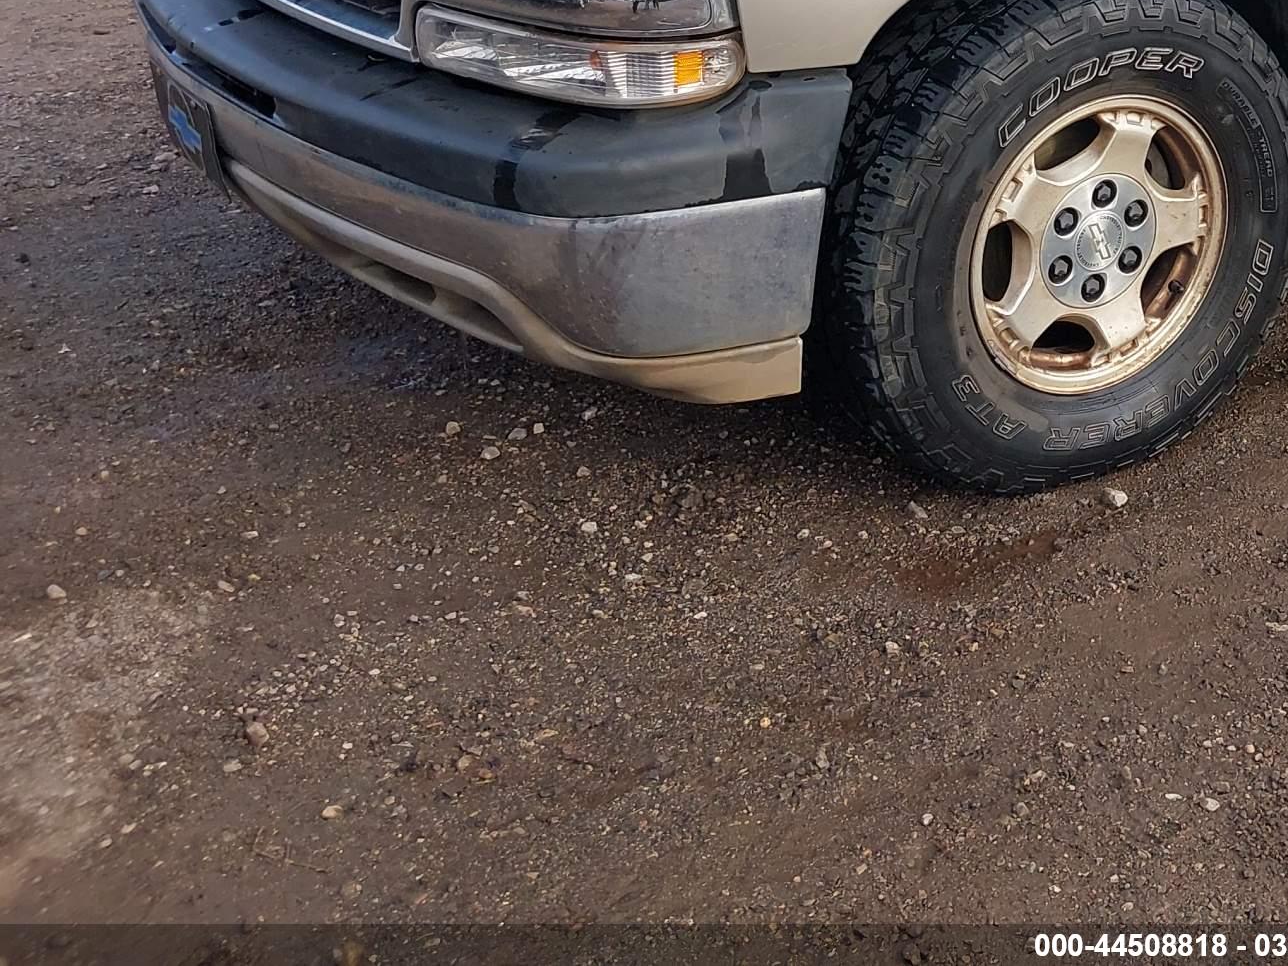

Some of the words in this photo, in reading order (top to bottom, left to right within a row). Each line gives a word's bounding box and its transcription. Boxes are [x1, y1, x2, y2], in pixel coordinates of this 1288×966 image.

[998, 48, 1205, 147] COOPER
[1043, 239, 1274, 452] DISCOVERER
[952, 374, 1029, 440] AT3
